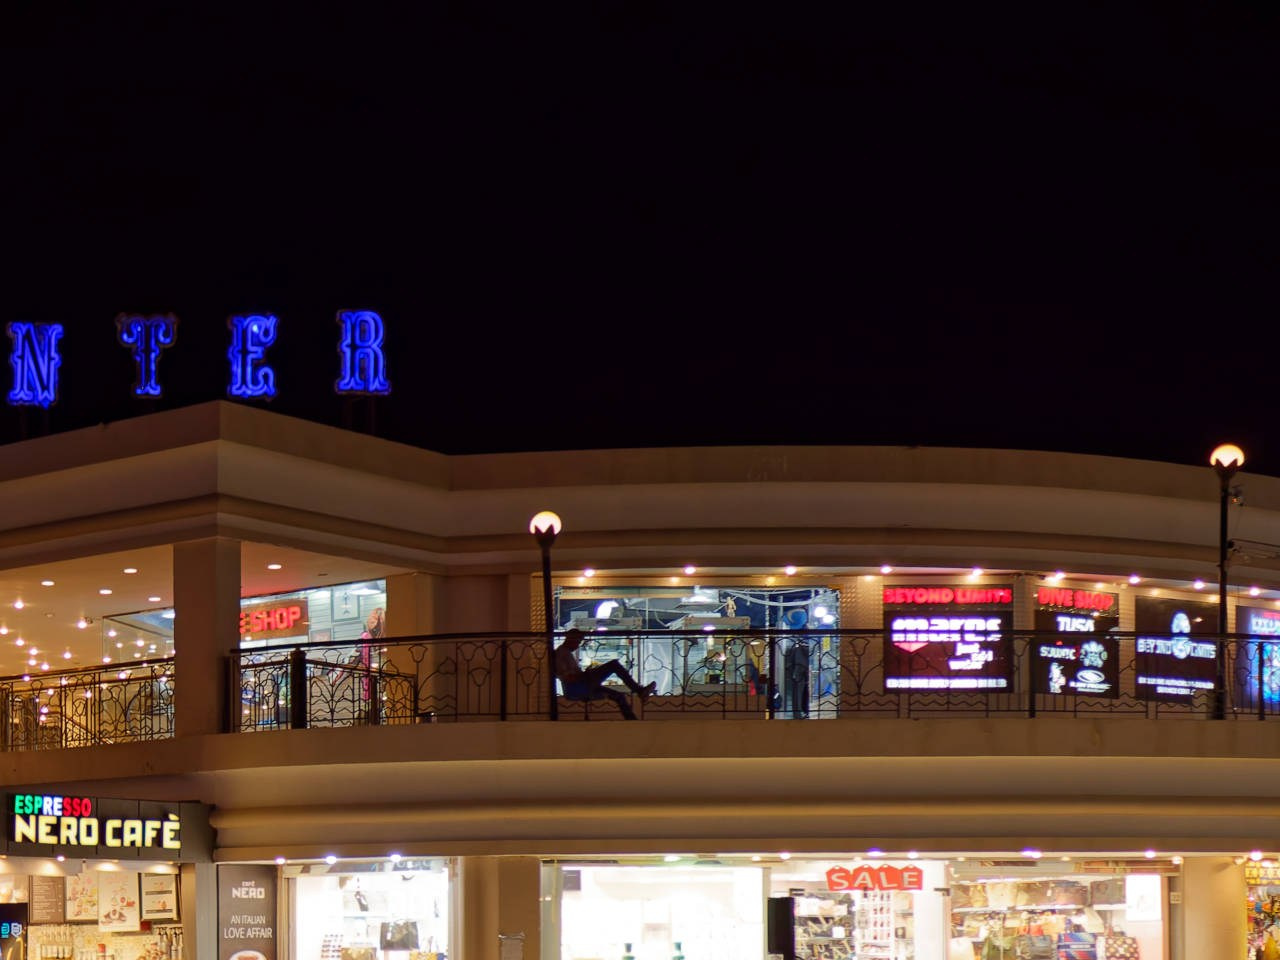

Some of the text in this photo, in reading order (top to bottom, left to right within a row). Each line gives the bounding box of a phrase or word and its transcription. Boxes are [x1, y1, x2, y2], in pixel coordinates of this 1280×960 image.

[883, 587, 1012, 604] BEYOND LIMITS
[1037, 587, 1114, 611] DIVE SHOP
[250, 605, 301, 634] SHOP
[14, 795, 92, 817] ESPRESSO
[15, 814, 99, 846] NERO
[831, 871, 920, 890] SALE
[231, 887, 266, 899] NERO
[230, 914, 266, 925] AN ITALIAN
[223, 927, 273, 939] LOVE AFFAIR
